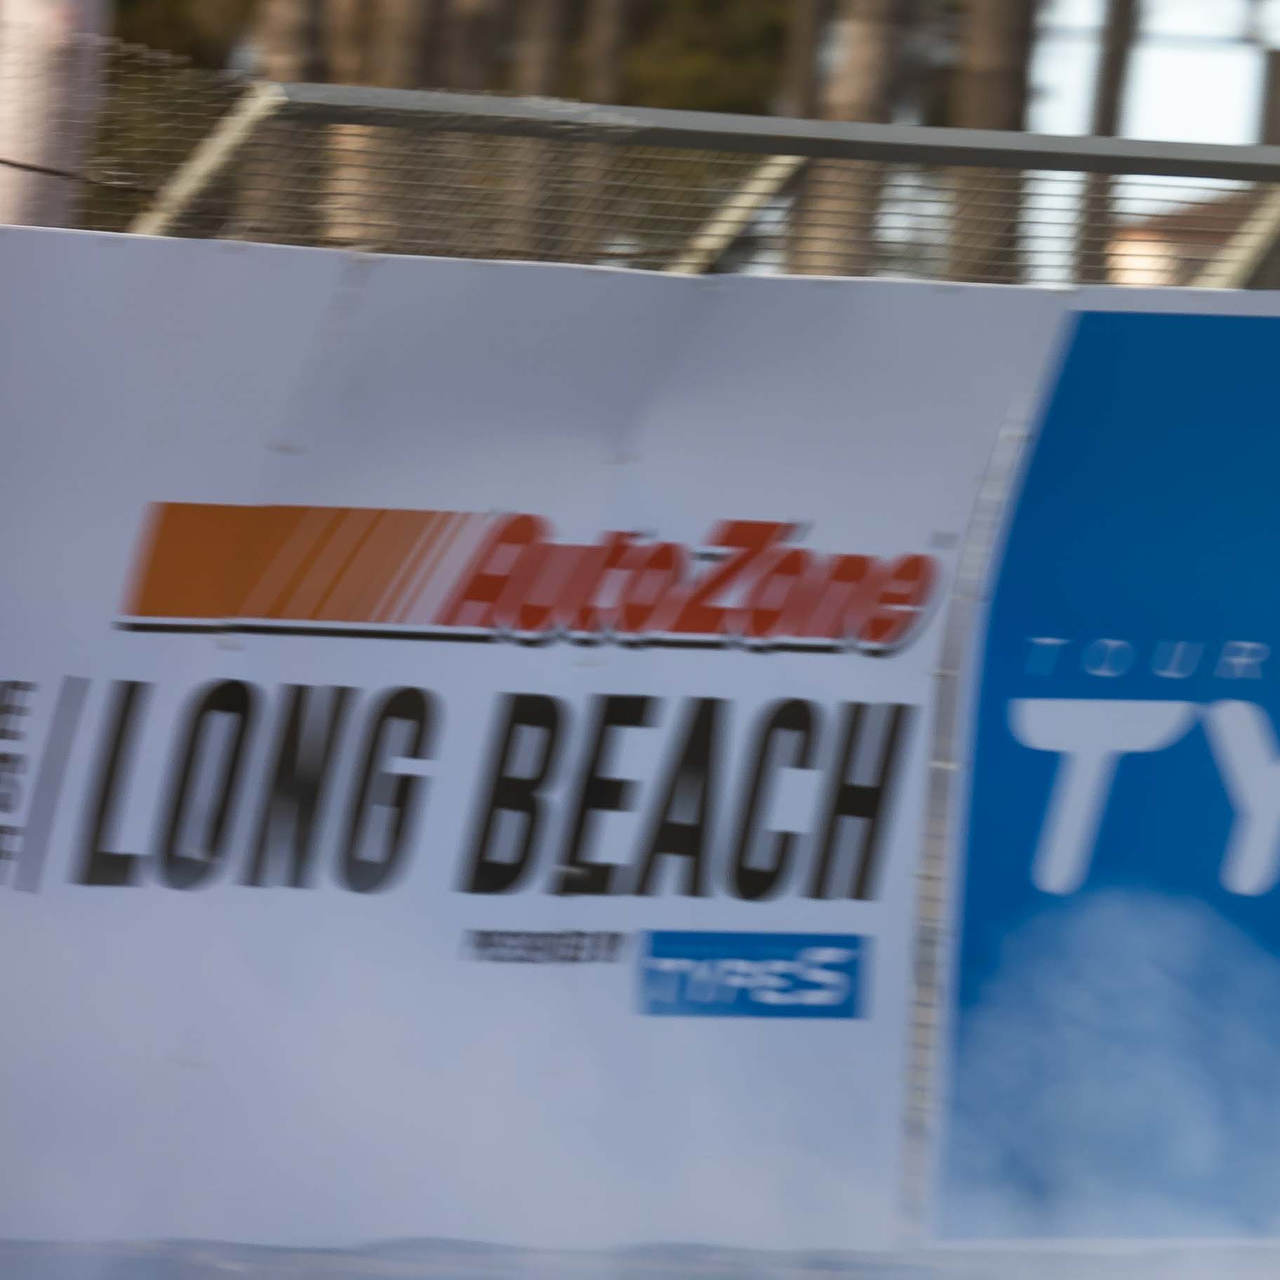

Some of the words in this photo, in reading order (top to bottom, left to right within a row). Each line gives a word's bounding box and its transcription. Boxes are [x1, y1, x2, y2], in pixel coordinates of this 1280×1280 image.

[434, 512, 938, 656] AutoZone
[72, 679, 445, 894] LONG
[457, 693, 918, 902] BEACH
